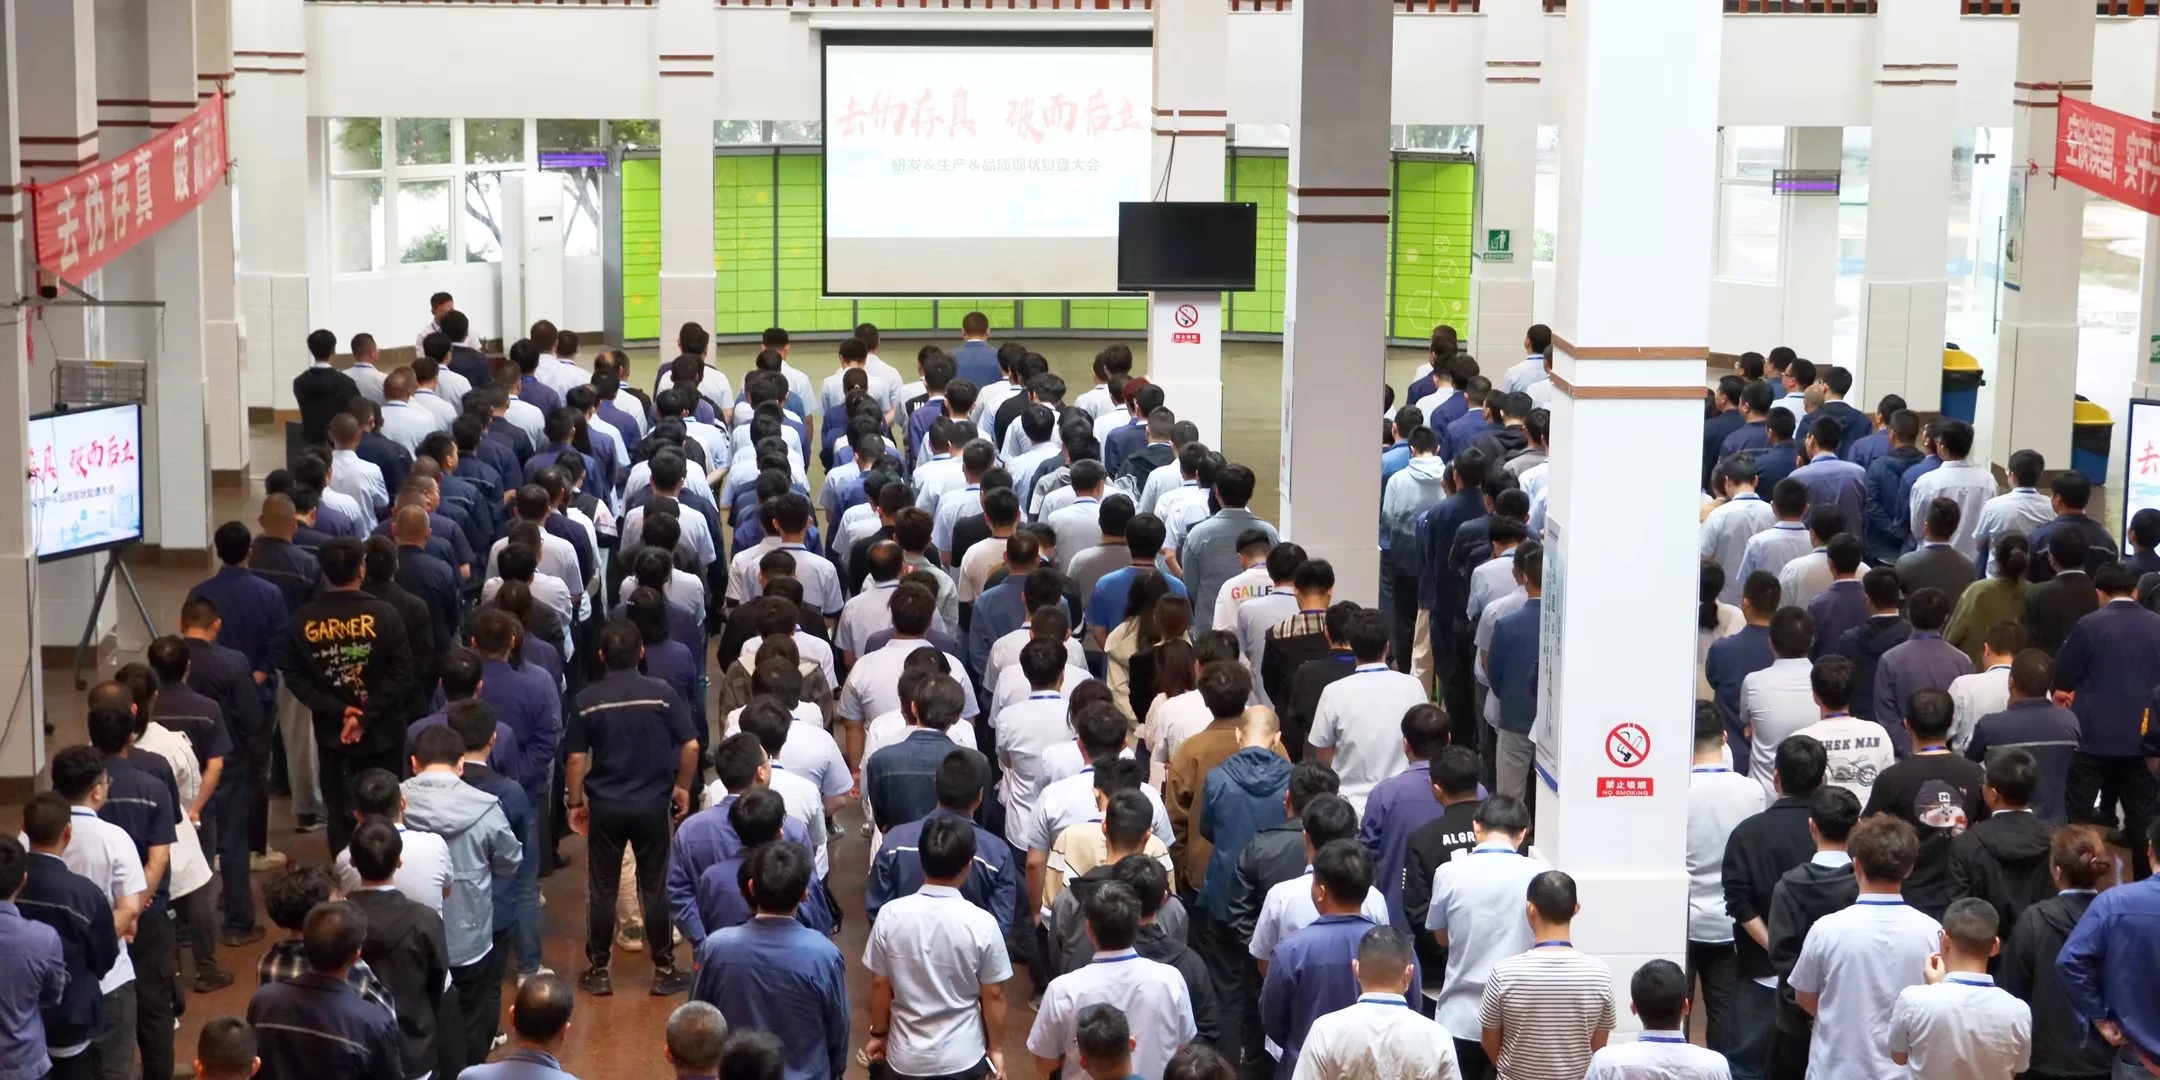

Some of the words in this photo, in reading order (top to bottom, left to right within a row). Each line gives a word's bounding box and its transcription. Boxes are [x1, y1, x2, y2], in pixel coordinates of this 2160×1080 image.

[836, 85, 976, 139] 去伪存真
[1005, 88, 1144, 144] 破而后立
[57, 147, 153, 272] 去伪存真
[304, 614, 377, 643] GARNER
[1855, 737, 1881, 749] MAN
